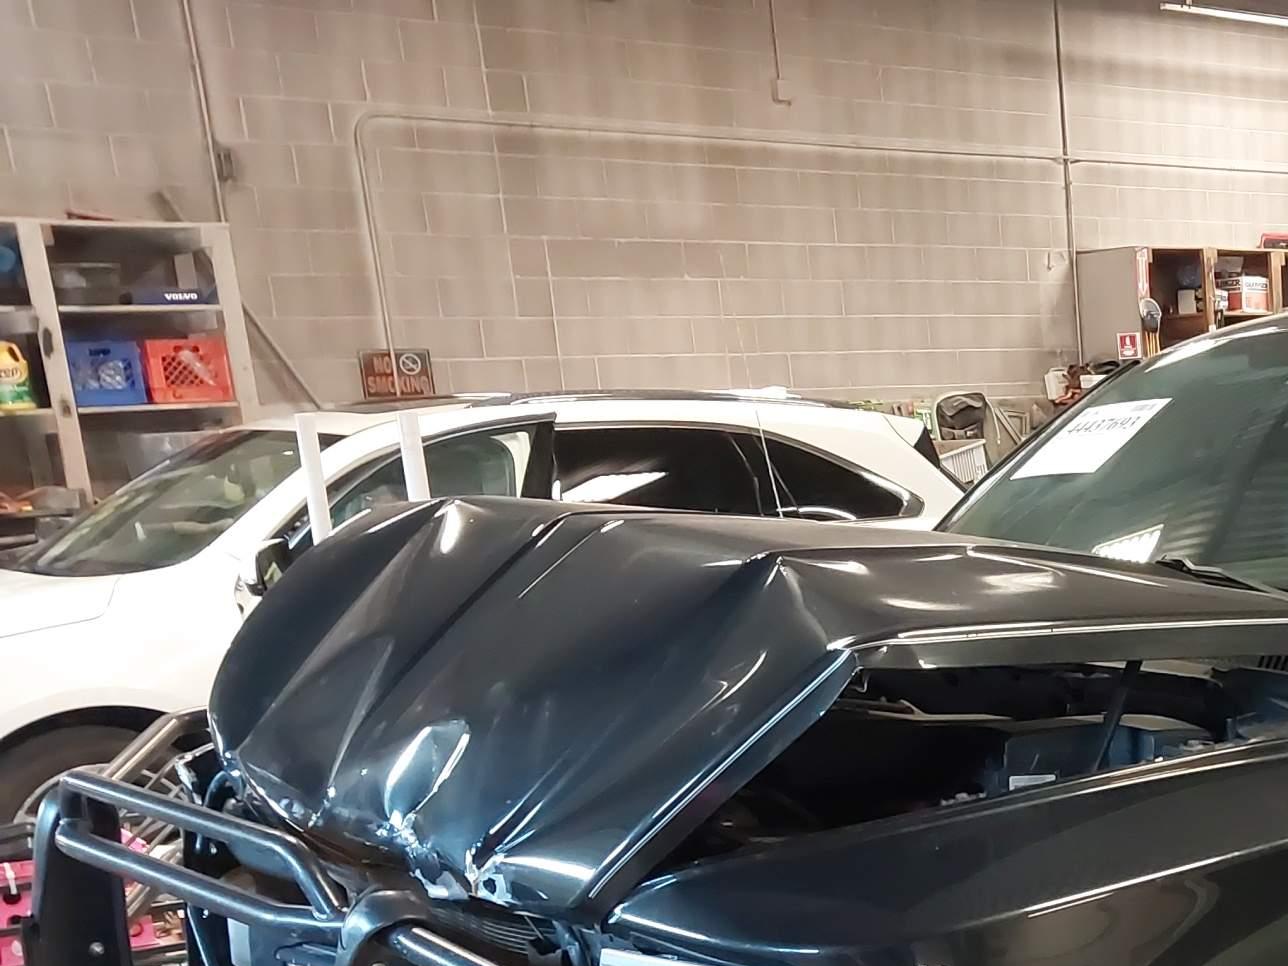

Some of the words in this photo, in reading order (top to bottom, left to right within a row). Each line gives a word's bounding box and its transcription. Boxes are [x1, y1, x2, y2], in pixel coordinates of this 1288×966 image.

[164, 293, 198, 301] VOLVO
[373, 356, 392, 374] NO
[367, 375, 429, 393] SMOKING
